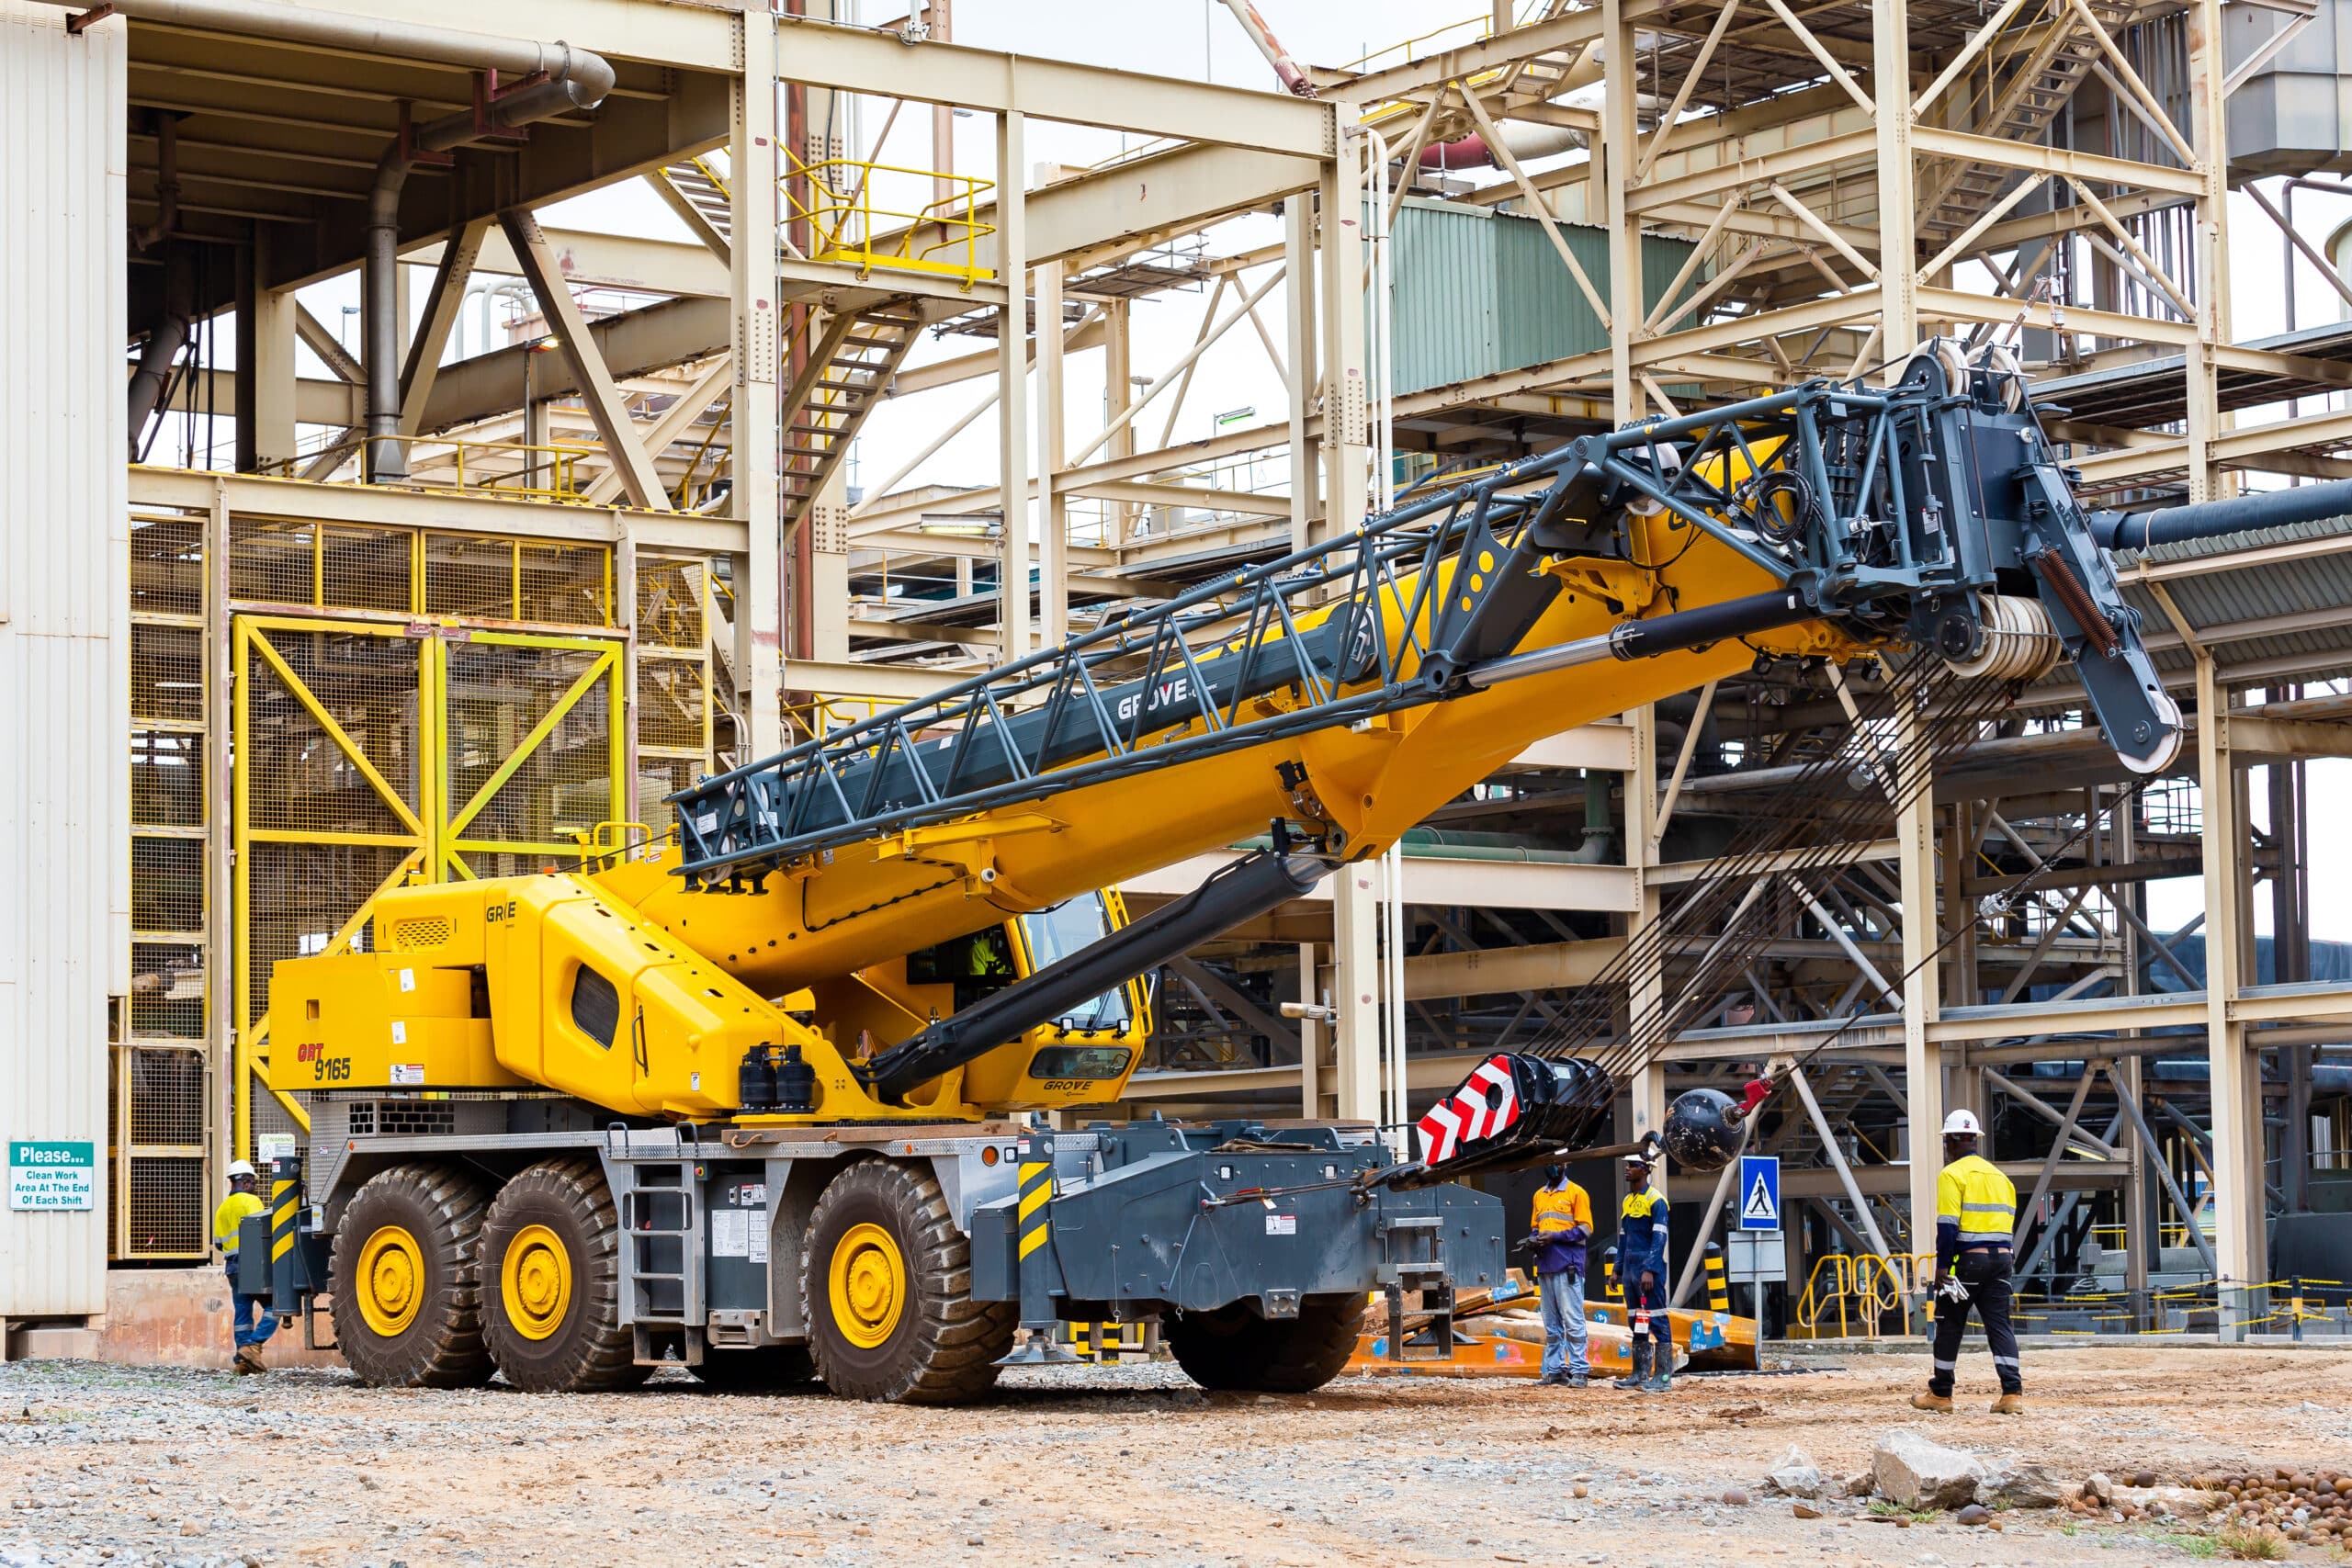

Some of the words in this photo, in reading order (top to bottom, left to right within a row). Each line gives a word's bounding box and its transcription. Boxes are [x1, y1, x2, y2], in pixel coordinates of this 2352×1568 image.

[297, 1043, 324, 1063] GRT
[314, 1057, 351, 1081] 9165
[1043, 1081, 1093, 1090] GROVE
[19, 1146, 85, 1163] Please...
[26, 1170, 52, 1179] Clean
[54, 1170, 79, 1179] Work
[15, 1183, 37, 1192] Area
[39, 1183, 50, 1192] At
[51, 1183, 70, 1192] The
[72, 1183, 89, 1192] End
[22, 1195, 33, 1204] Of
[35, 1195, 58, 1204] Each
[61, 1195, 83, 1204] Shift
